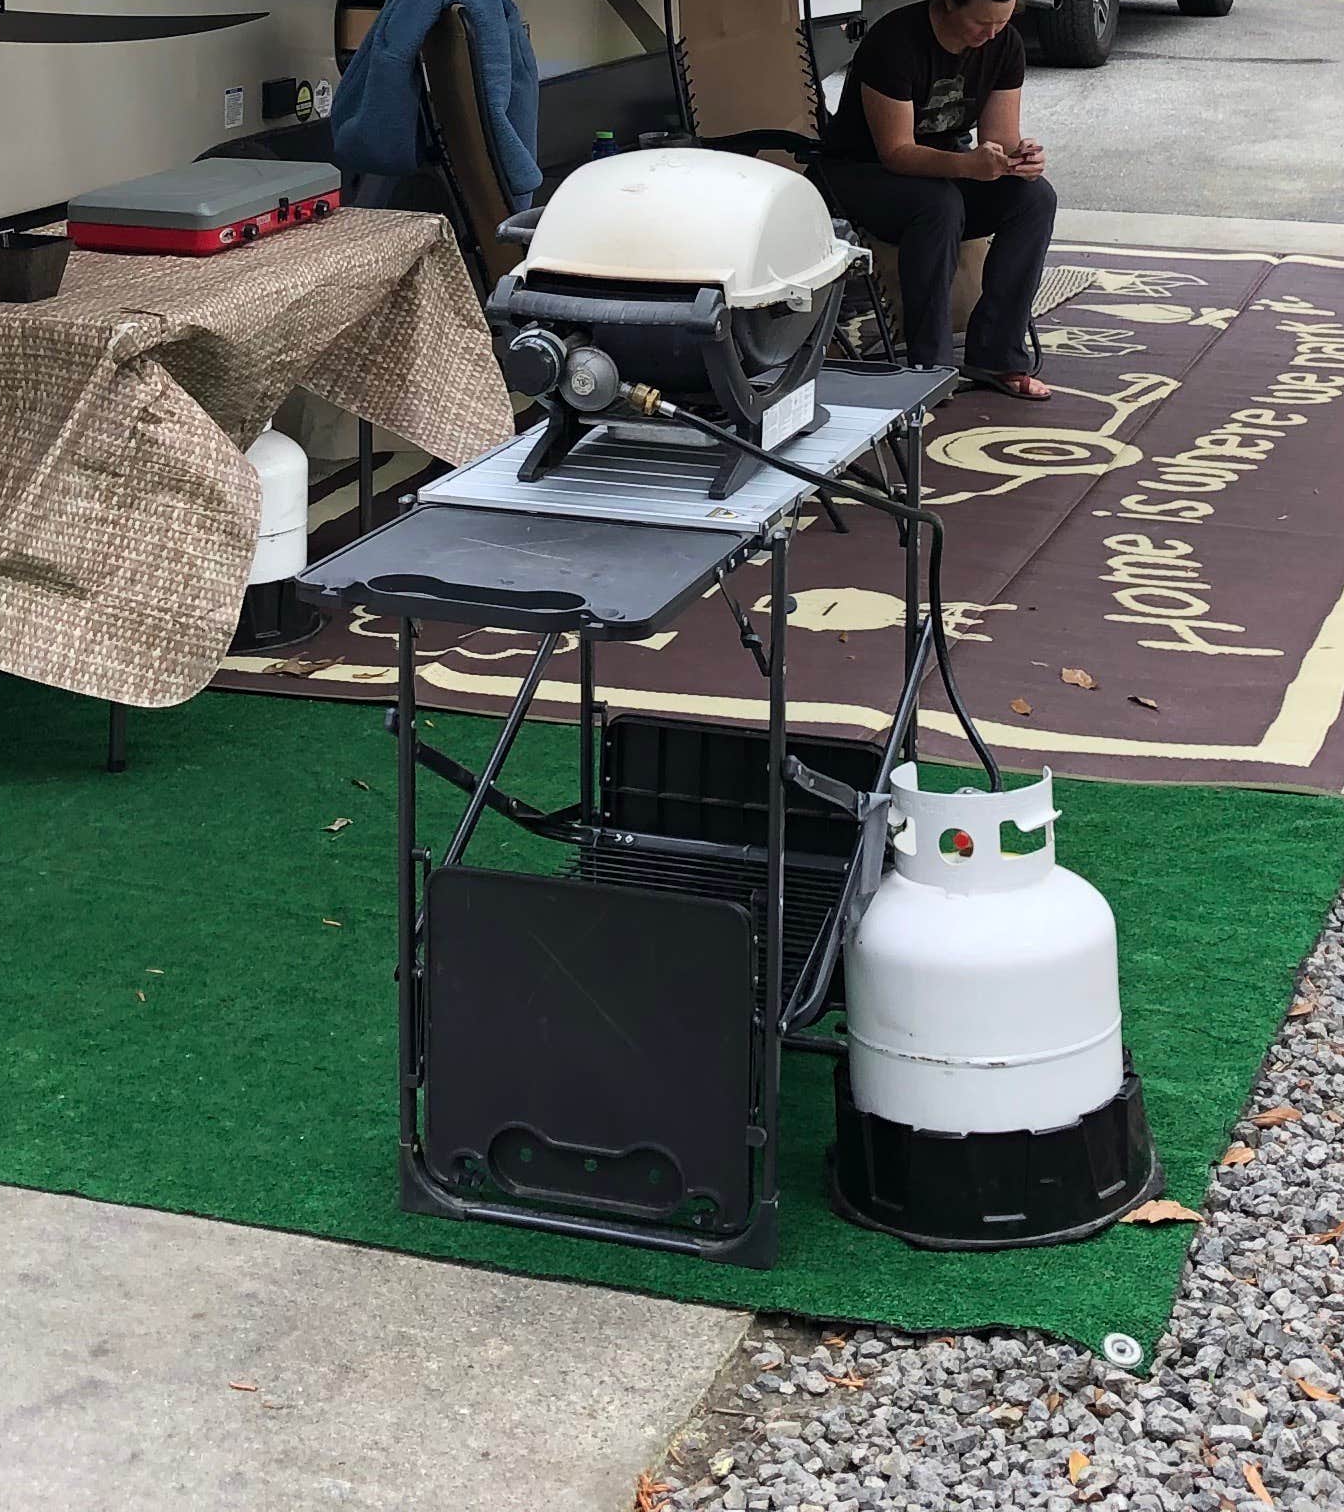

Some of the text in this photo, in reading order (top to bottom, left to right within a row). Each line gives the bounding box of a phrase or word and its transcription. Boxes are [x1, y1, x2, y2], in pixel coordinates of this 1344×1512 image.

[1136, 408, 1309, 492] where
[1092, 494, 1215, 524] is
[1097, 533, 1285, 656] Home
